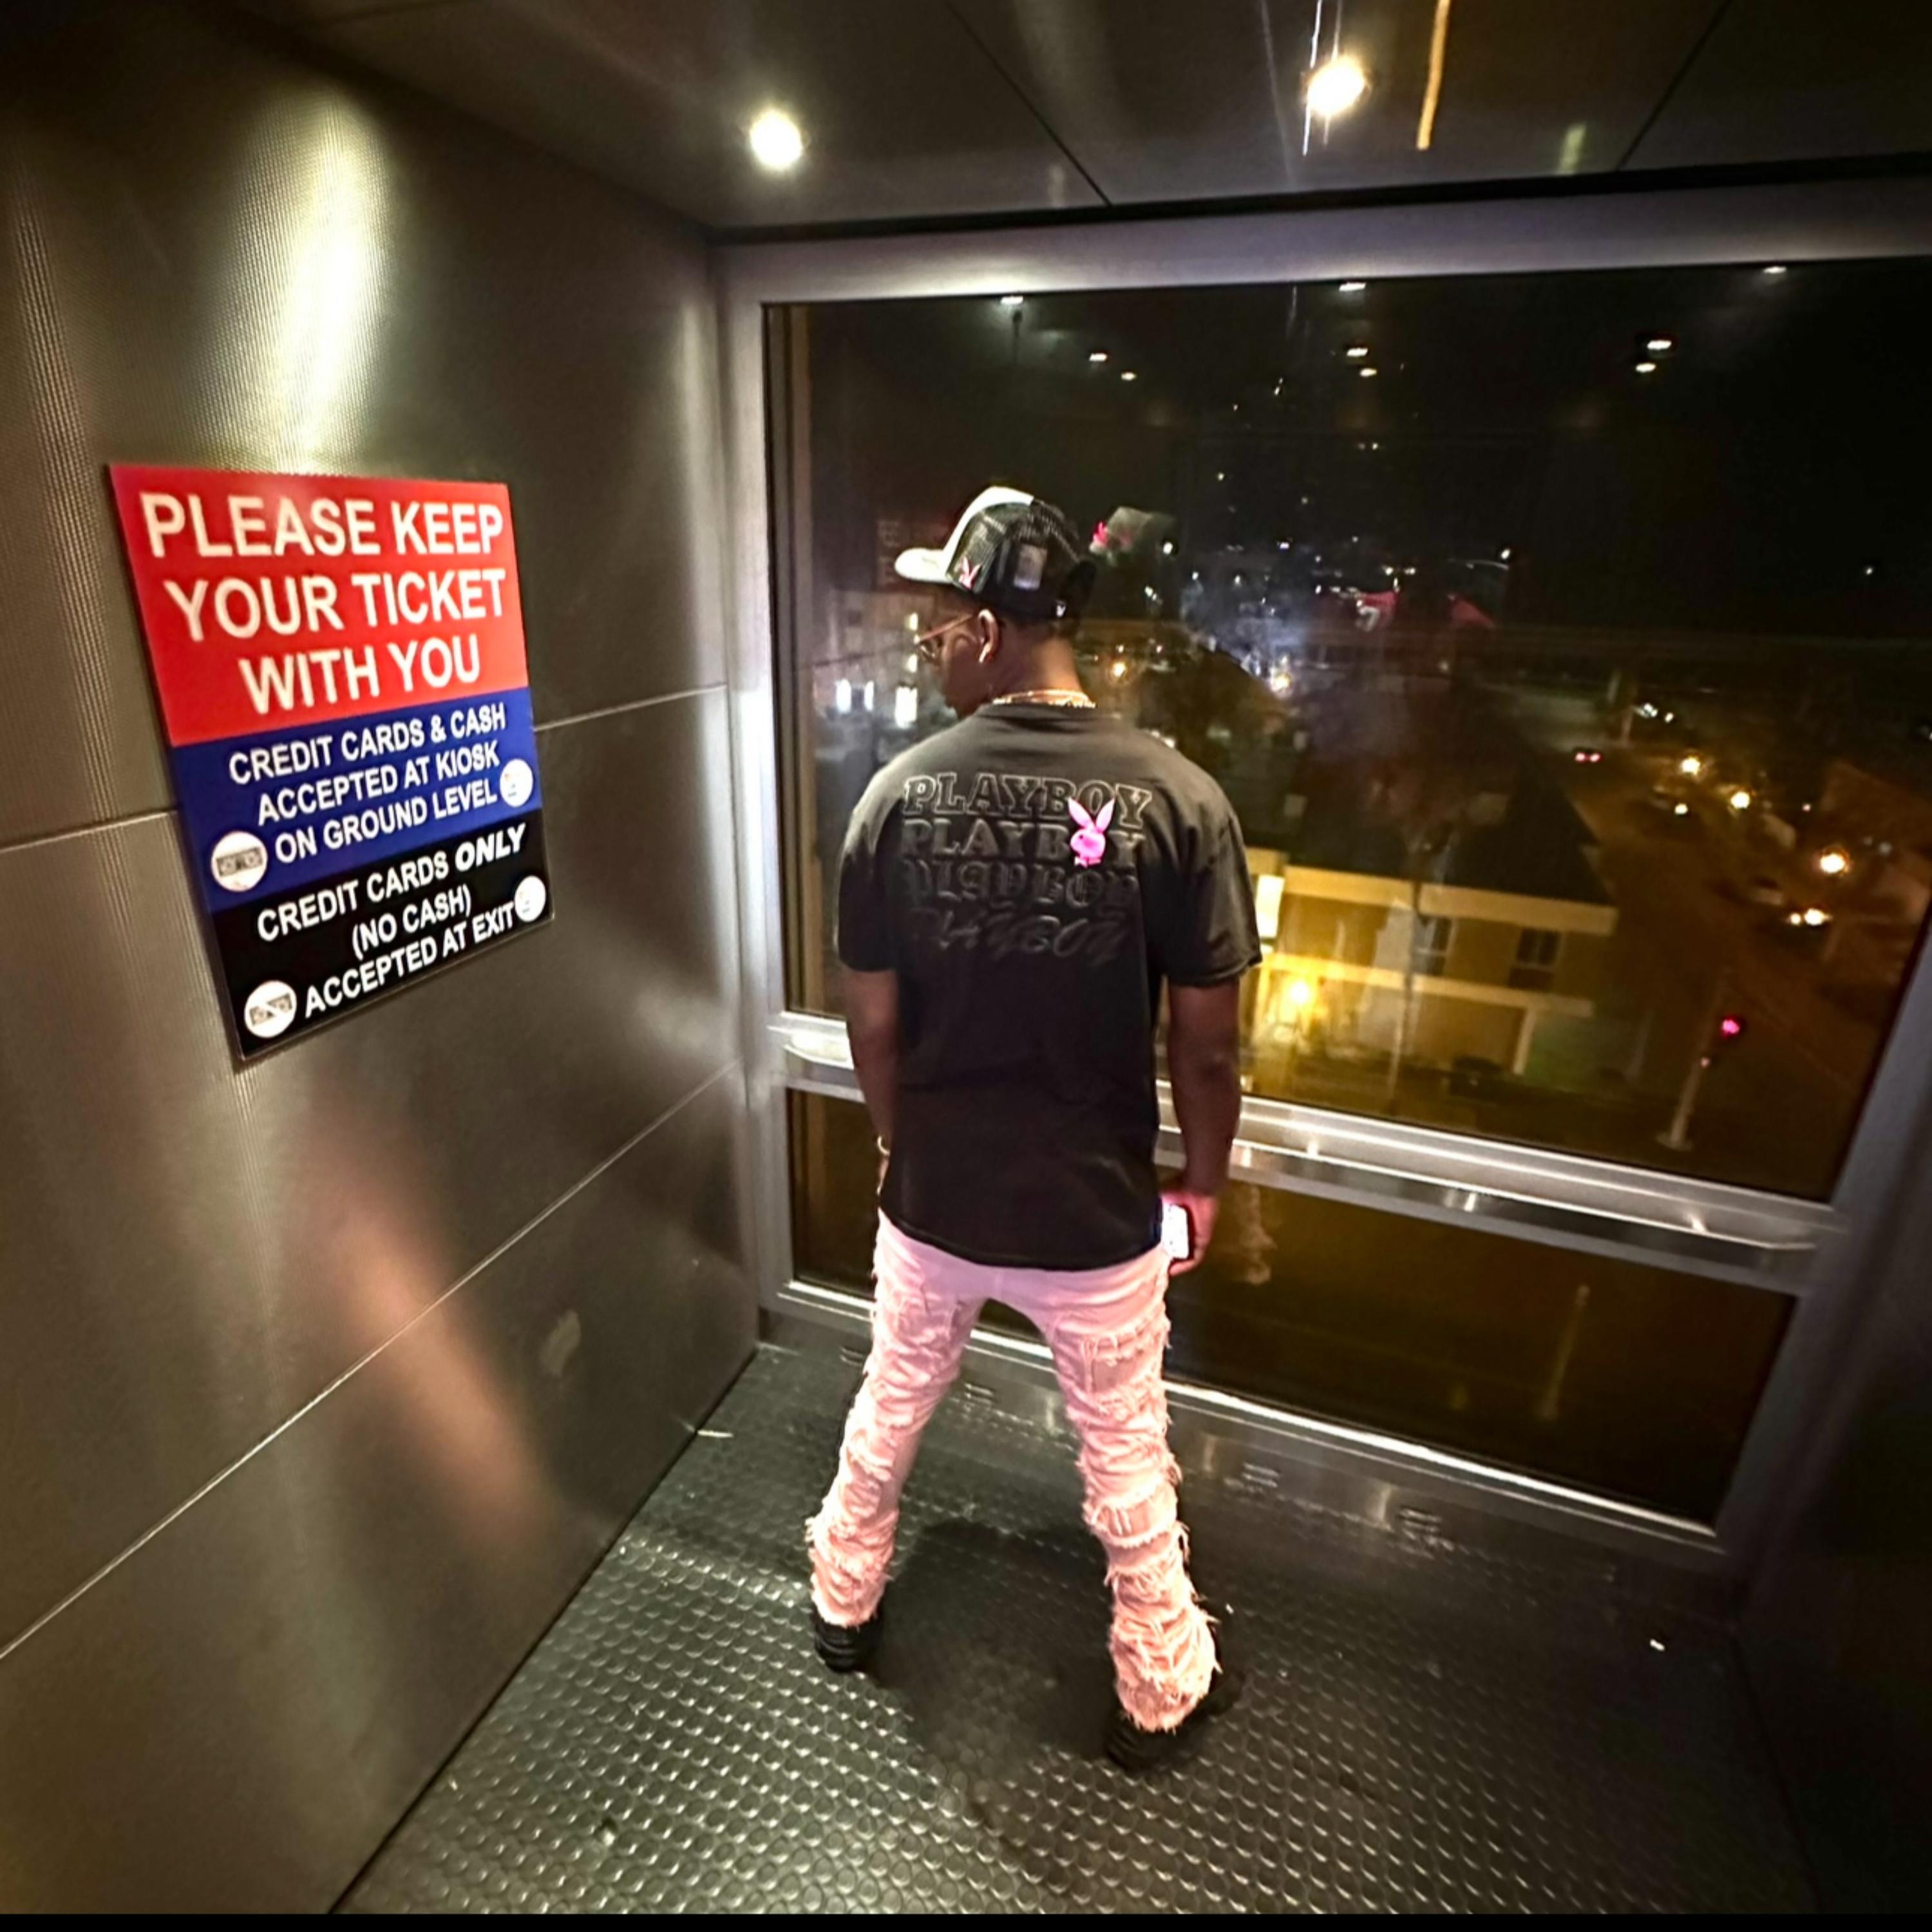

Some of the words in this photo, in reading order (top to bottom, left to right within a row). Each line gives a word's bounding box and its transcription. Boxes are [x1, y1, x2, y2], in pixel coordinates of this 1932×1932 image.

[142, 494, 381, 557] PLEASE
[391, 502, 504, 555] KEEP
[165, 576, 344, 641] YOUR
[351, 567, 507, 627] TICKET
[240, 645, 380, 714] WITH
[387, 633, 481, 692] YOU
[229, 735, 333, 784] CREDIT
[341, 718, 425, 761] CARDS
[430, 714, 447, 743] &
[450, 701, 506, 739] CASH
[258, 764, 398, 826] ACCEPTED
[404, 755, 430, 789] AT
[435, 739, 500, 781] KIOSK
[275, 826, 317, 863] ON
[323, 797, 428, 849] GROUND
[432, 778, 498, 819] LEVEL
[903, 772, 1152, 829] PLAYBOY
[258, 880, 359, 941] CREDIT
[366, 851, 449, 902] CARDS
[455, 822, 526, 871] ONLY
[902, 818, 1147, 867] PLAYBY
[305, 936, 437, 1018] ACCEPTED
[442, 921, 467, 957] AT
[471, 901, 515, 943] EXIT
[352, 913, 397, 960] (NO
[402, 884, 471, 933] CASH)
